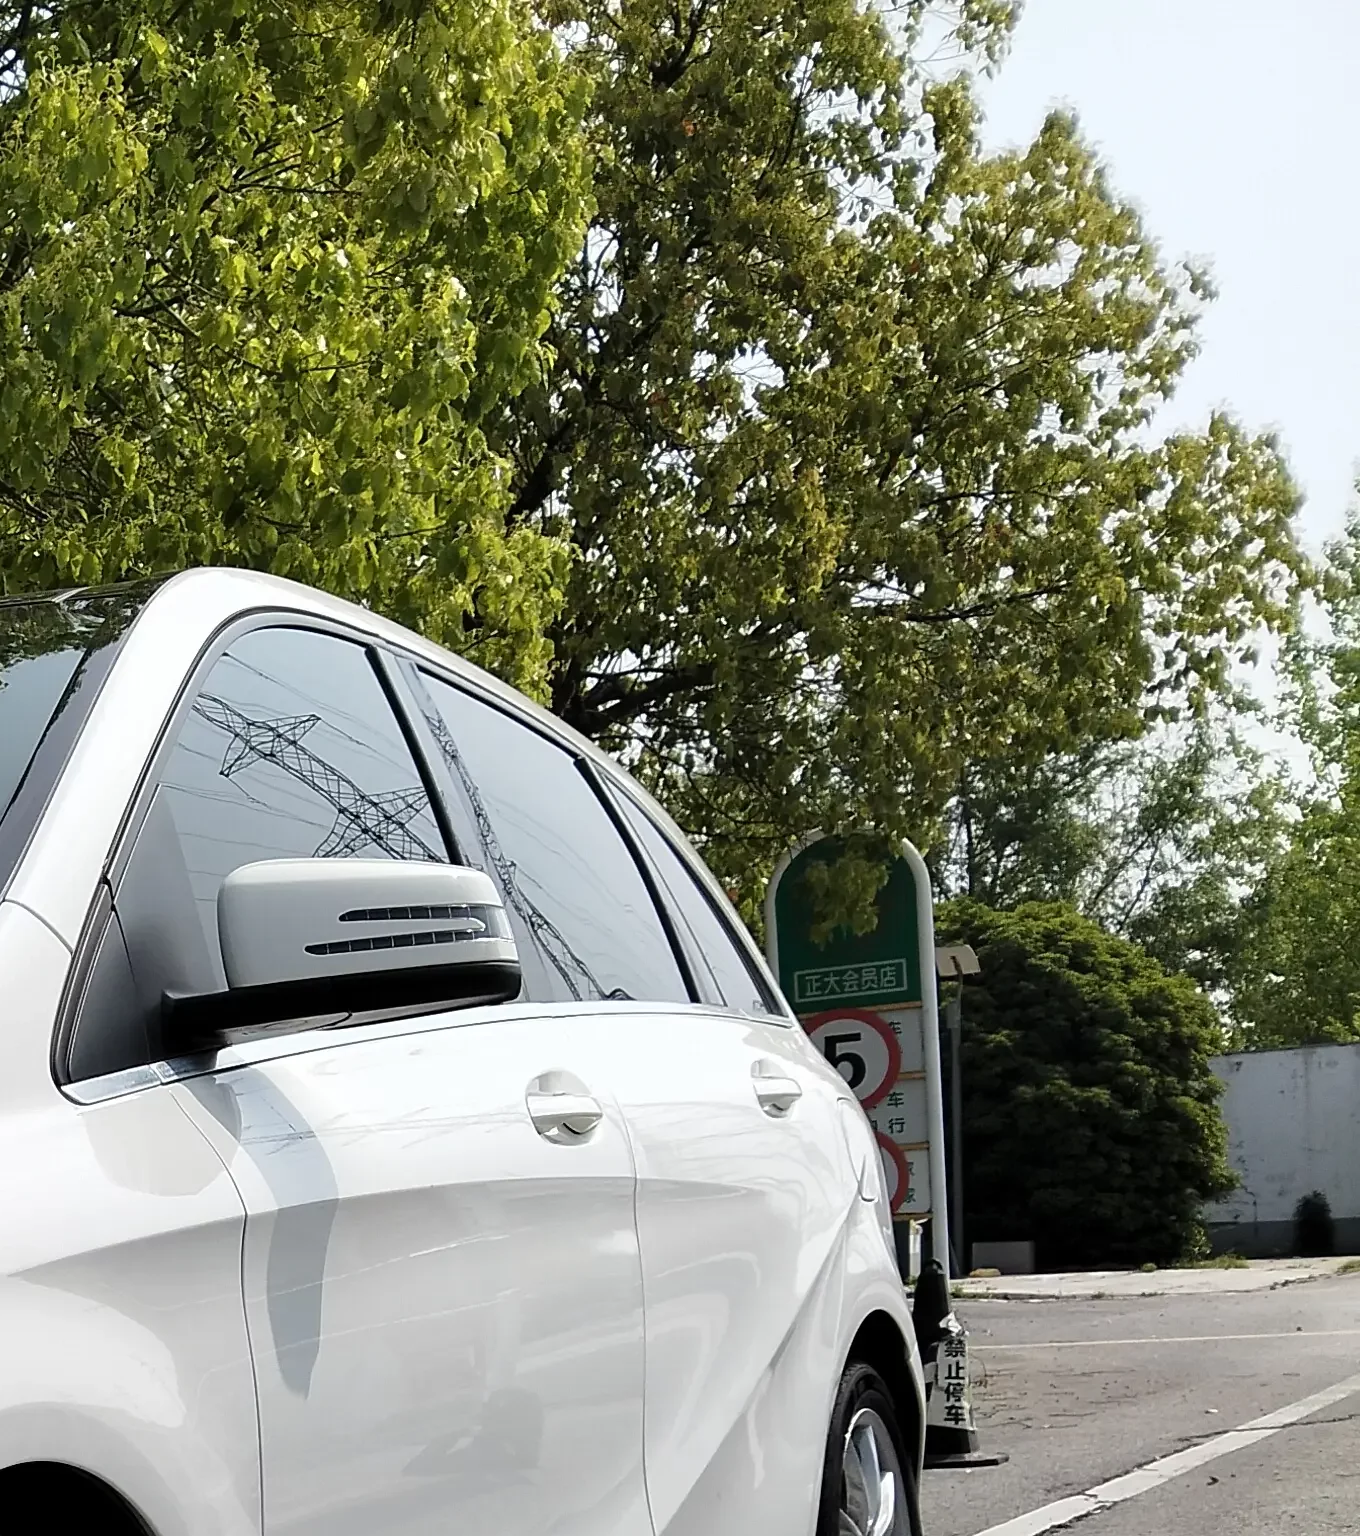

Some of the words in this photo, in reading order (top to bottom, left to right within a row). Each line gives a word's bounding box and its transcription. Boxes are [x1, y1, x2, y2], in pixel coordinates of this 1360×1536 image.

[805, 966, 897, 996] 正大会员店
[824, 1032, 866, 1090] 5
[944, 1338, 966, 1425] 禁止停车
